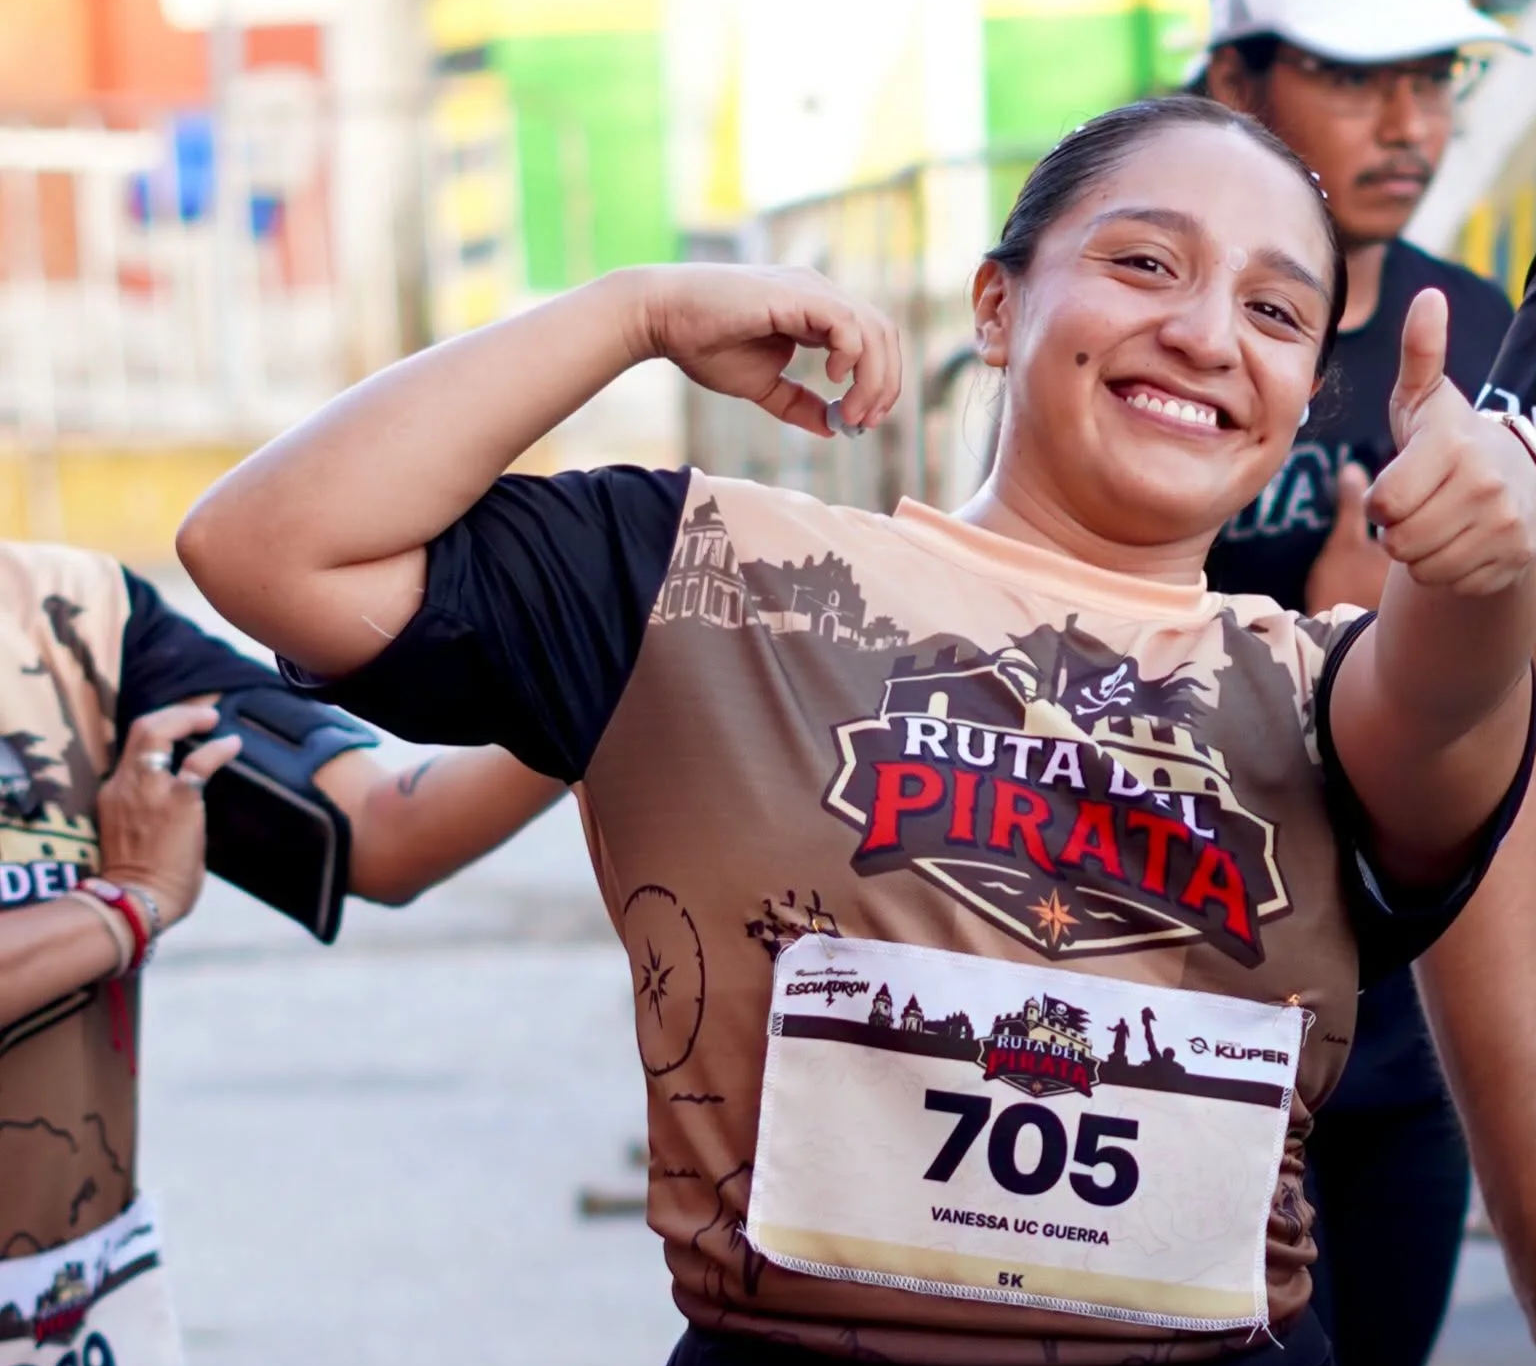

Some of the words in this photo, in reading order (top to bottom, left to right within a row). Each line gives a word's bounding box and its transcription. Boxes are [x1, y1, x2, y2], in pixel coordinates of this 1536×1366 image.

[903, 716, 1086, 789] RUTA
[859, 761, 1254, 943] PIRATA
[786, 980, 870, 1001] ESCUADRON
[997, 1035, 1046, 1053] RUTA
[1050, 1042, 1083, 1063] DEL
[1215, 1044, 1289, 1066] KUPER
[986, 1048, 1092, 1093] PIRATA
[923, 1088, 1139, 1207] 705
[931, 1206, 1009, 1232] VANESSA
[1013, 1218, 1039, 1235] UC
[1042, 1222, 1110, 1246] GUERRA
